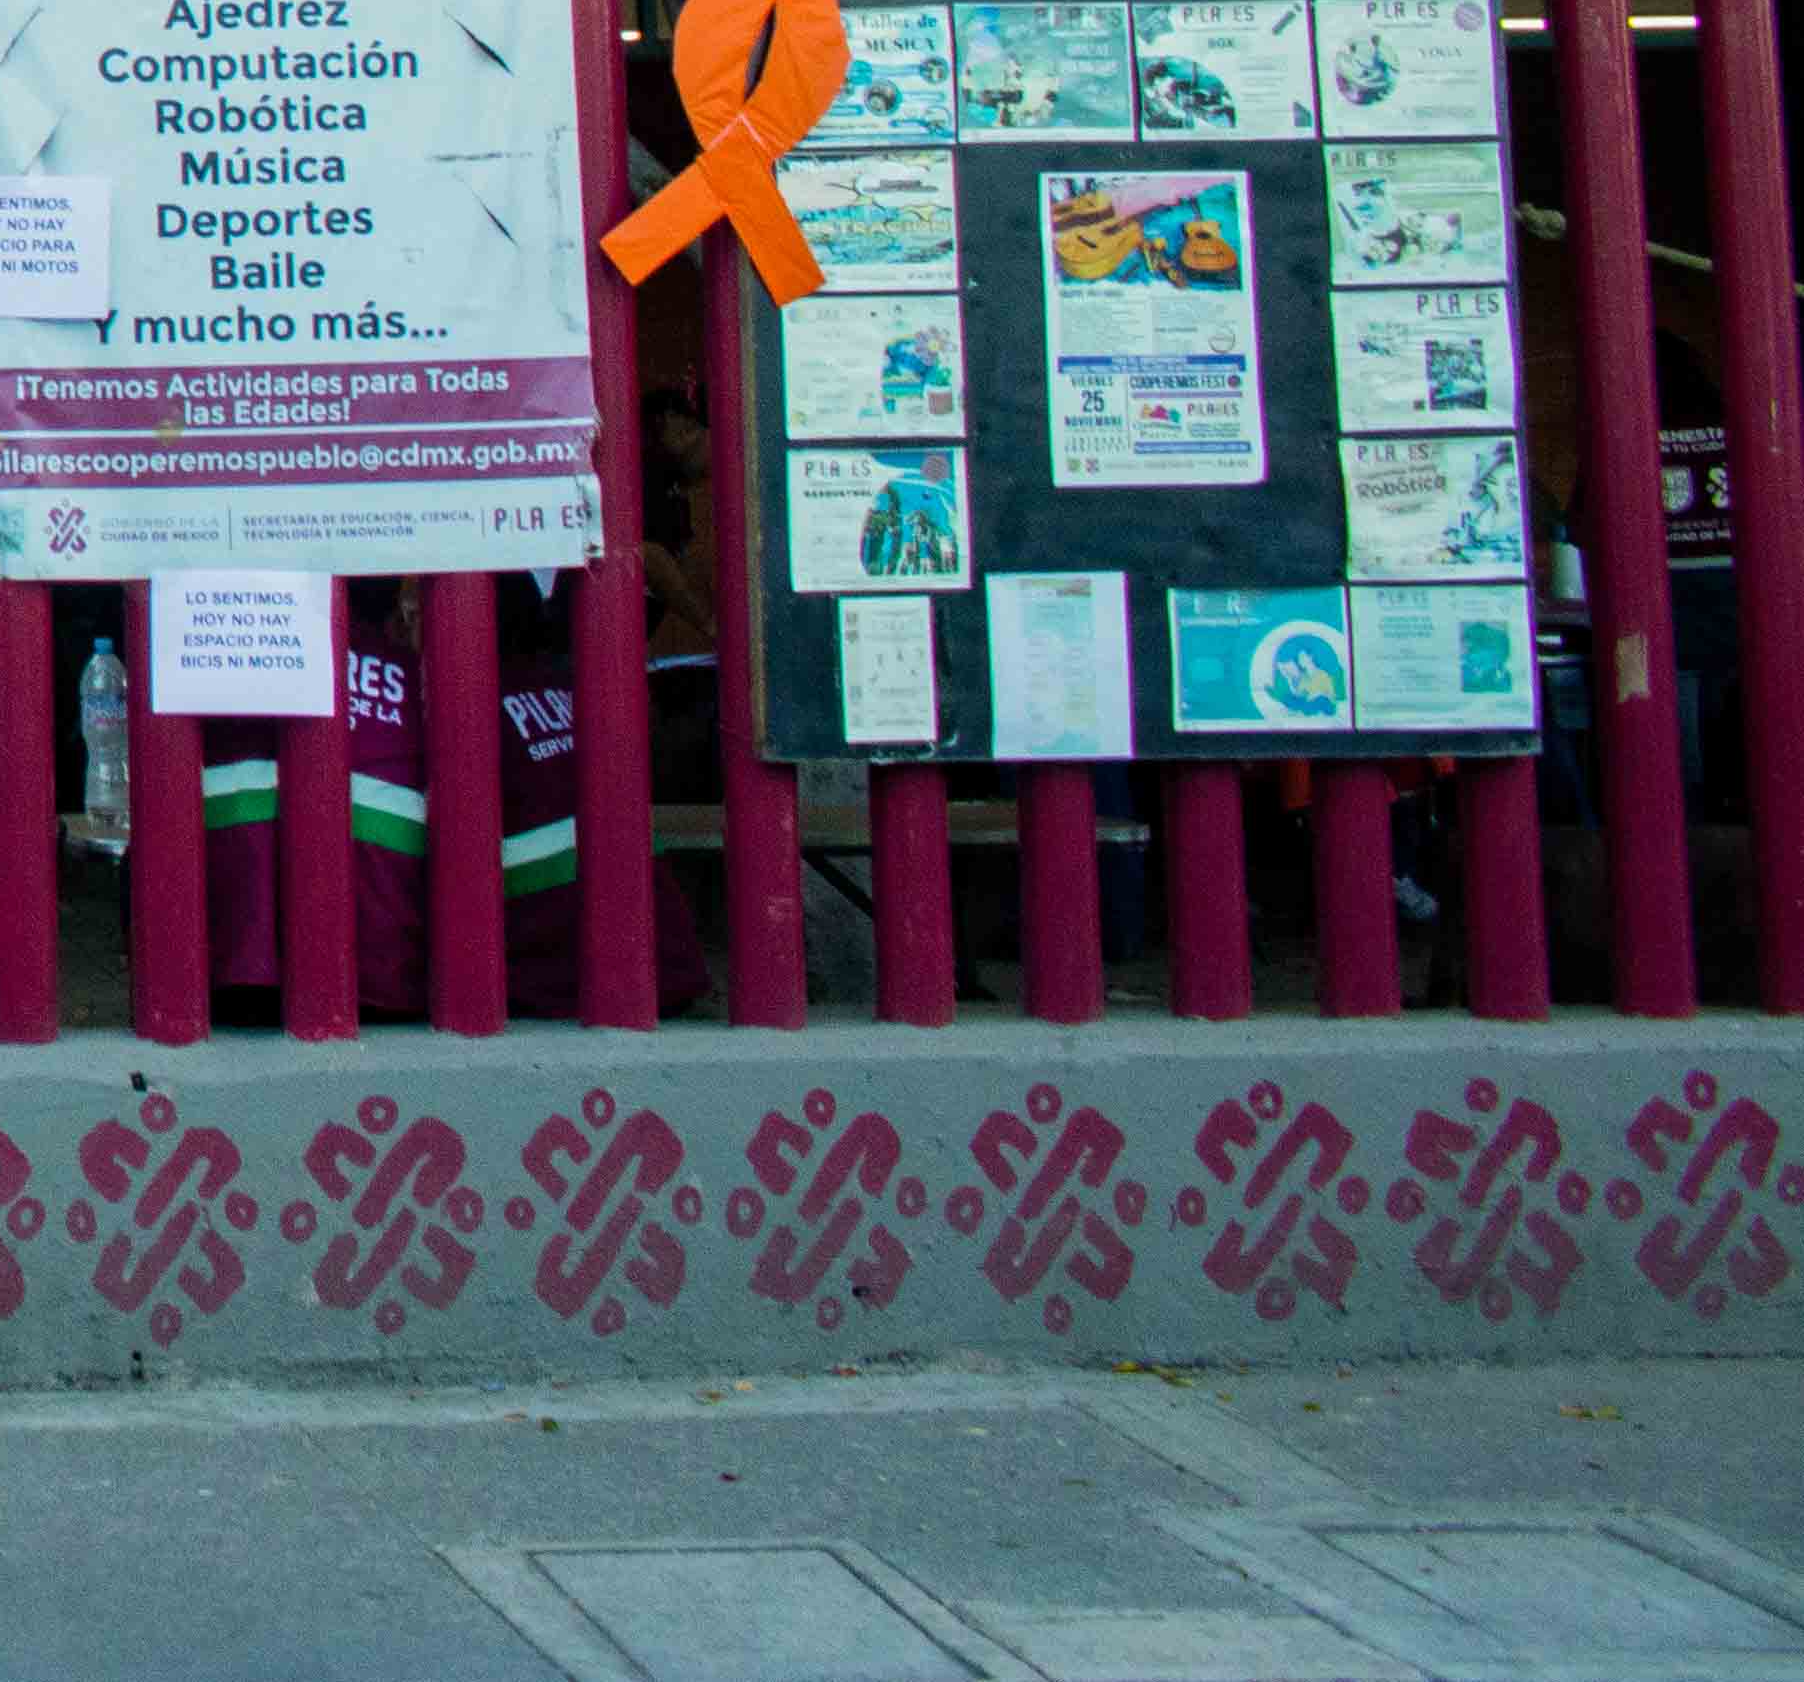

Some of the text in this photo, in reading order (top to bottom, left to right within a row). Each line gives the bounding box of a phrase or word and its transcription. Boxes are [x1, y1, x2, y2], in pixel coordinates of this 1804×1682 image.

[98, 40, 417, 91] Computación
[155, 93, 366, 135] Robótica
[180, 146, 345, 186] Música
[7, 219, 29, 230] NO
[35, 219, 65, 230] HAY
[156, 201, 373, 247] Deportes
[32, 240, 74, 252] PARA
[2, 260, 16, 272] NI
[22, 260, 79, 272] MOTOS
[210, 251, 325, 290] Baile
[133, 304, 295, 344] mucho
[311, 300, 448, 340] más...
[16, 365, 510, 401] ¡Tenemos Actividades para Todas
[184, 397, 351, 426] las Edades!
[1081, 390, 1104, 413] 25
[185, 592, 207, 605] LO
[193, 613, 292, 627] HOY NO HAY
[183, 634, 301, 648] ESPACIO PARA
[181, 655, 305, 670] BICIS NI MOTOS
